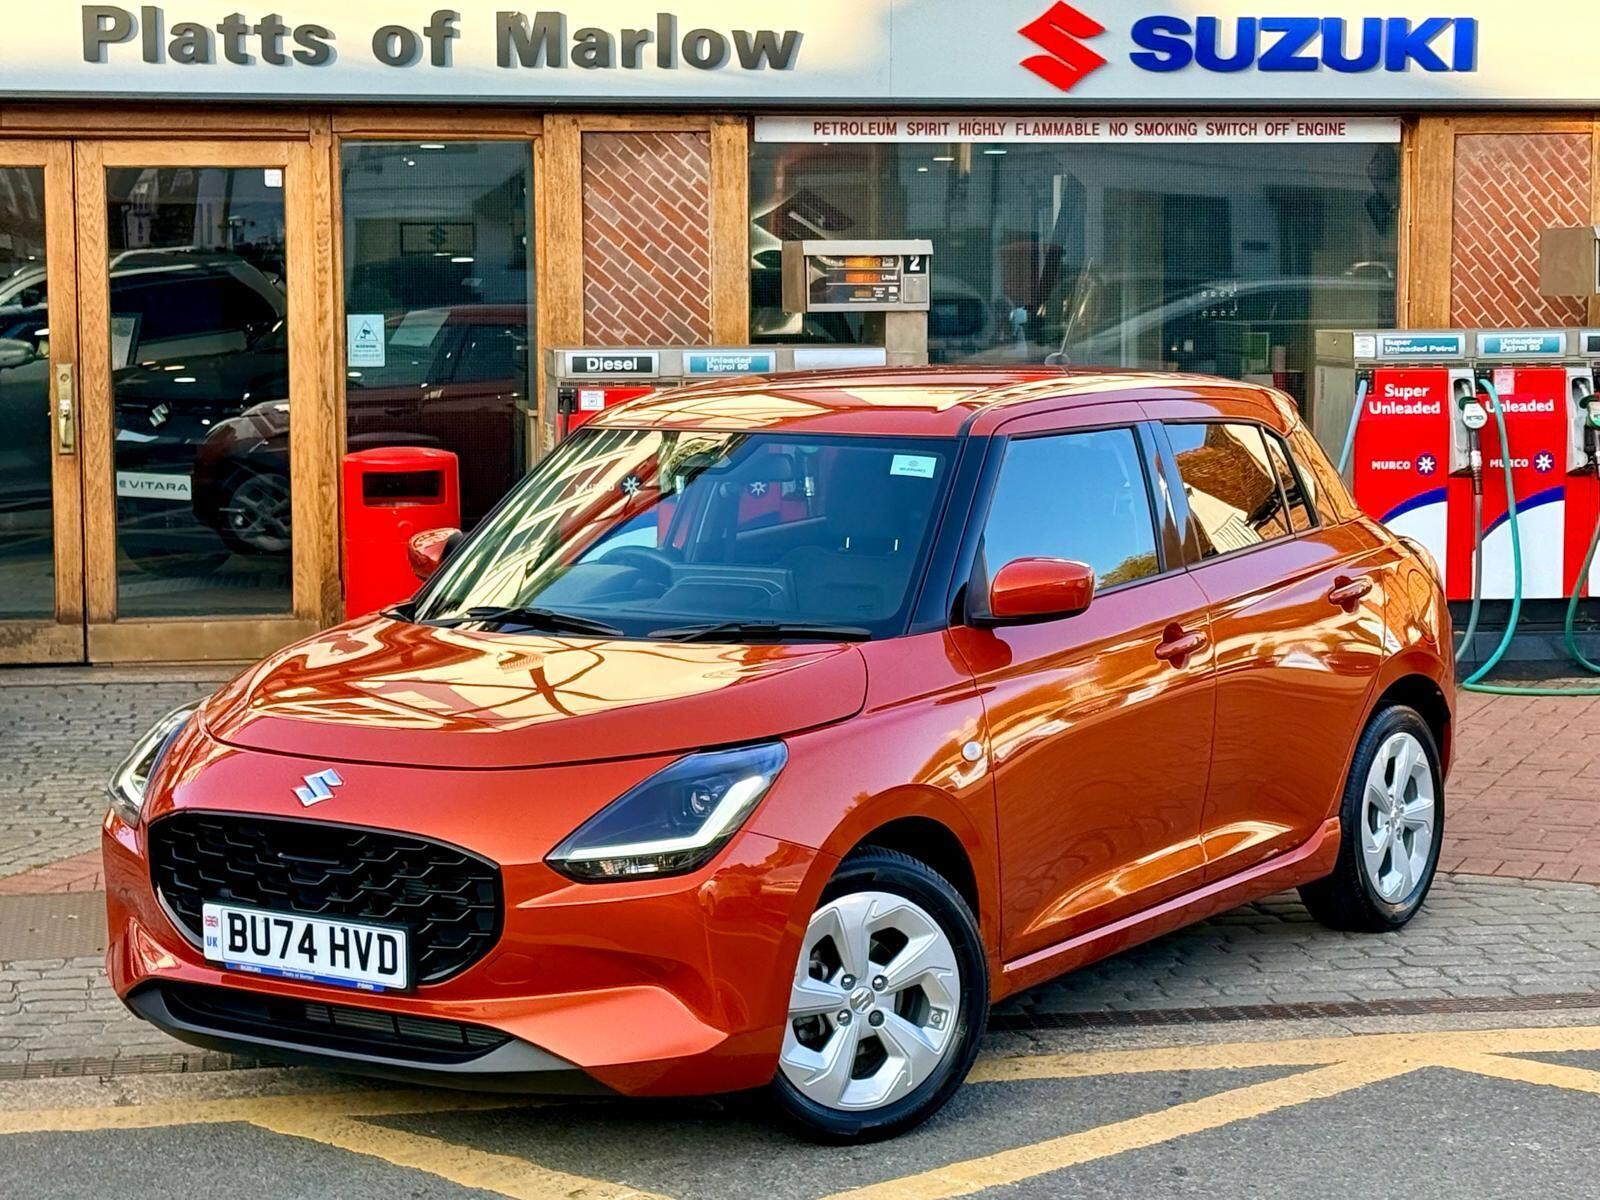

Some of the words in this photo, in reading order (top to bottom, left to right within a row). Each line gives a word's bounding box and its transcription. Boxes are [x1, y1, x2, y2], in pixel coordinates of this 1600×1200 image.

[82, 5, 335, 66] Platts
[371, 9, 460, 67] of
[496, 11, 803, 70] Marlow
[1130, 15, 1478, 73] SUZUKI
[813, 121, 897, 136] PETROLEUM
[906, 121, 950, 136] SPIRIT
[958, 121, 1006, 136] HIGHLY
[1015, 121, 1100, 136] FLAMMABLE
[1109, 121, 1128, 136] NO
[1134, 121, 1198, 136] SMOKING
[1205, 121, 1258, 136] SWITCH
[1264, 121, 1290, 136] OFF
[1296, 121, 1346, 136] ENGINE
[909, 255, 921, 271] 2
[1500, 337, 1544, 345] Unleaded
[586, 357, 638, 371] Diesel
[706, 356, 752, 364] Unleaded
[706, 363, 735, 371] Petrol
[1384, 383, 1430, 400] Super
[1368, 401, 1441, 414] Unleaded
[1371, 460, 1411, 470] MURCO
[128, 480, 188, 491] VITARA
[206, 935, 218, 948] UK
[227, 911, 318, 964] BU74
[328, 926, 398, 976] HVD
